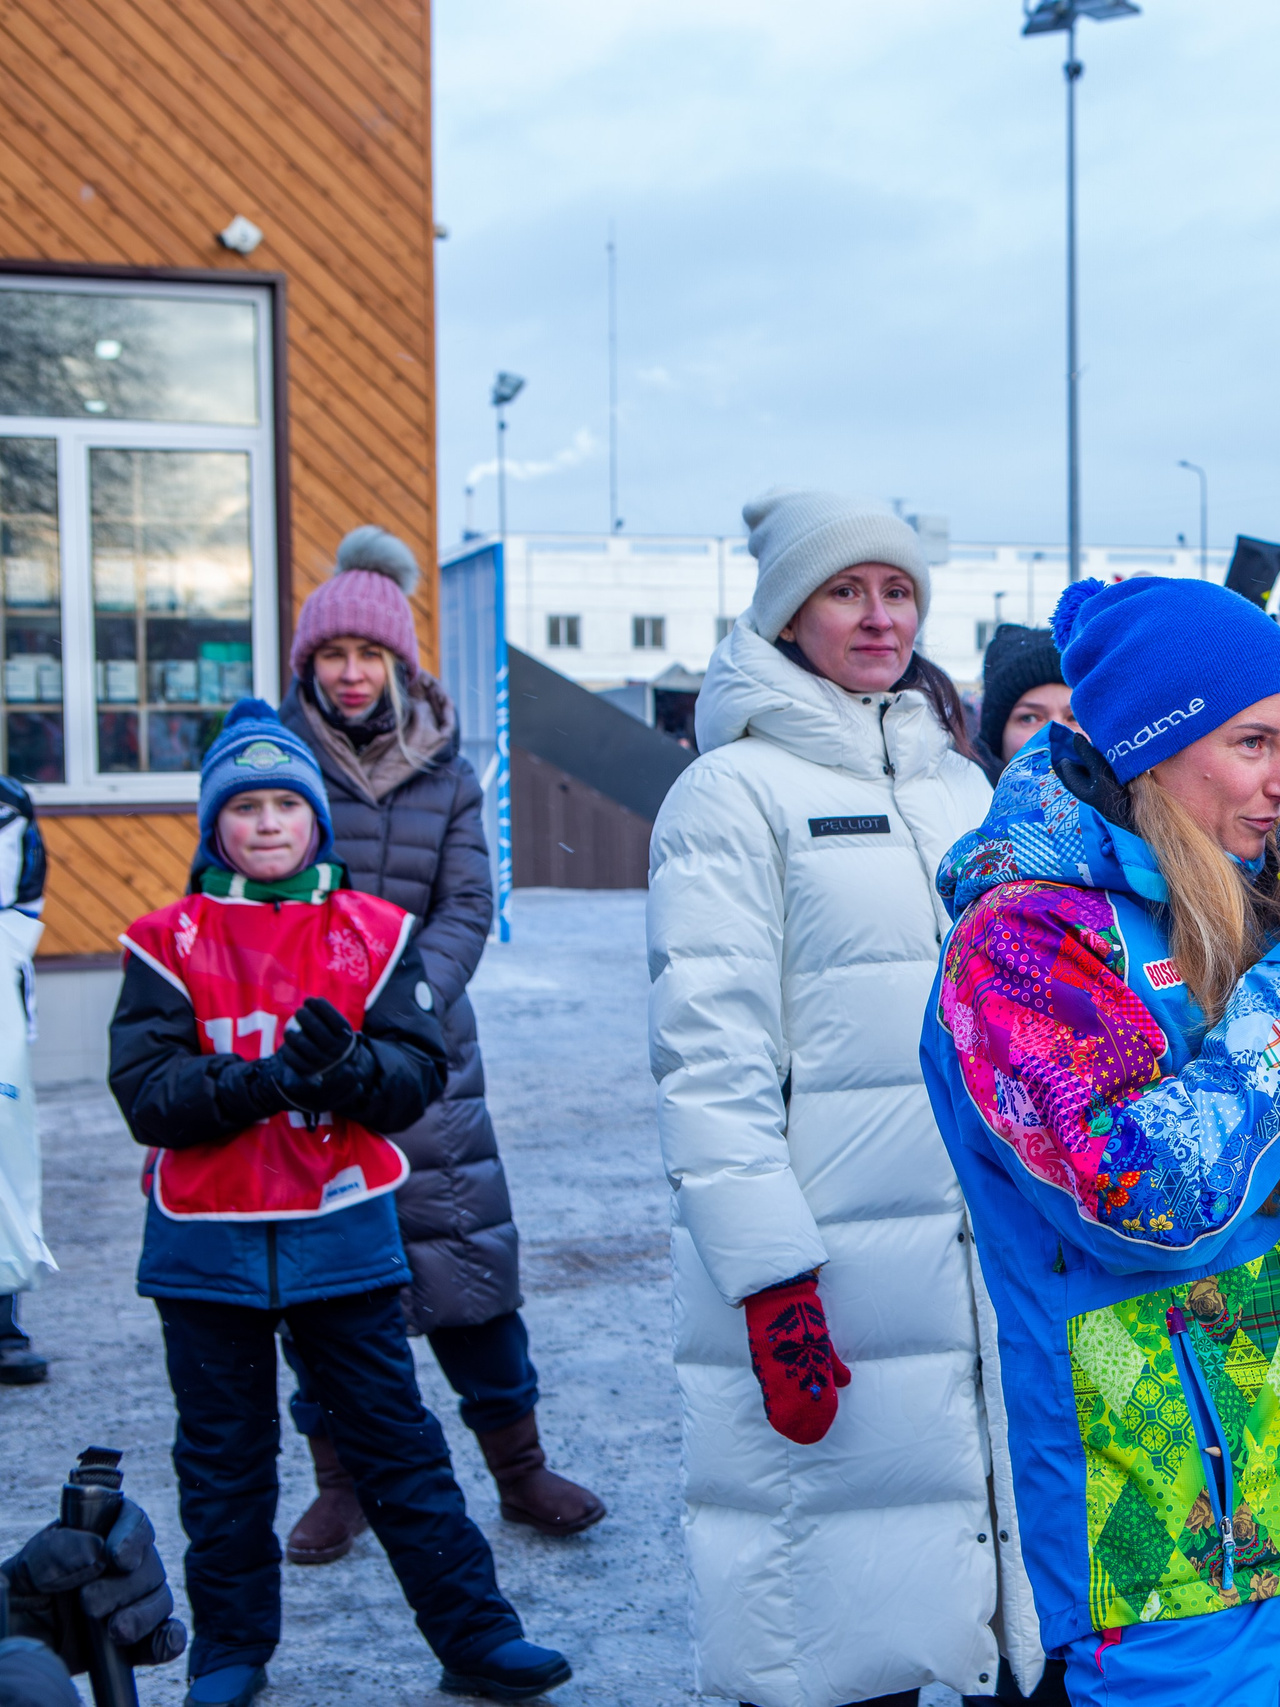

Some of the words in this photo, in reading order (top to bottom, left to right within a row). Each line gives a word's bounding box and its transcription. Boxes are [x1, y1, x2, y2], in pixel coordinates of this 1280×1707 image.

[1104, 698, 1205, 763] oname
[819, 818, 880, 832] PELLIOT
[1145, 961, 1182, 987] BOSC
